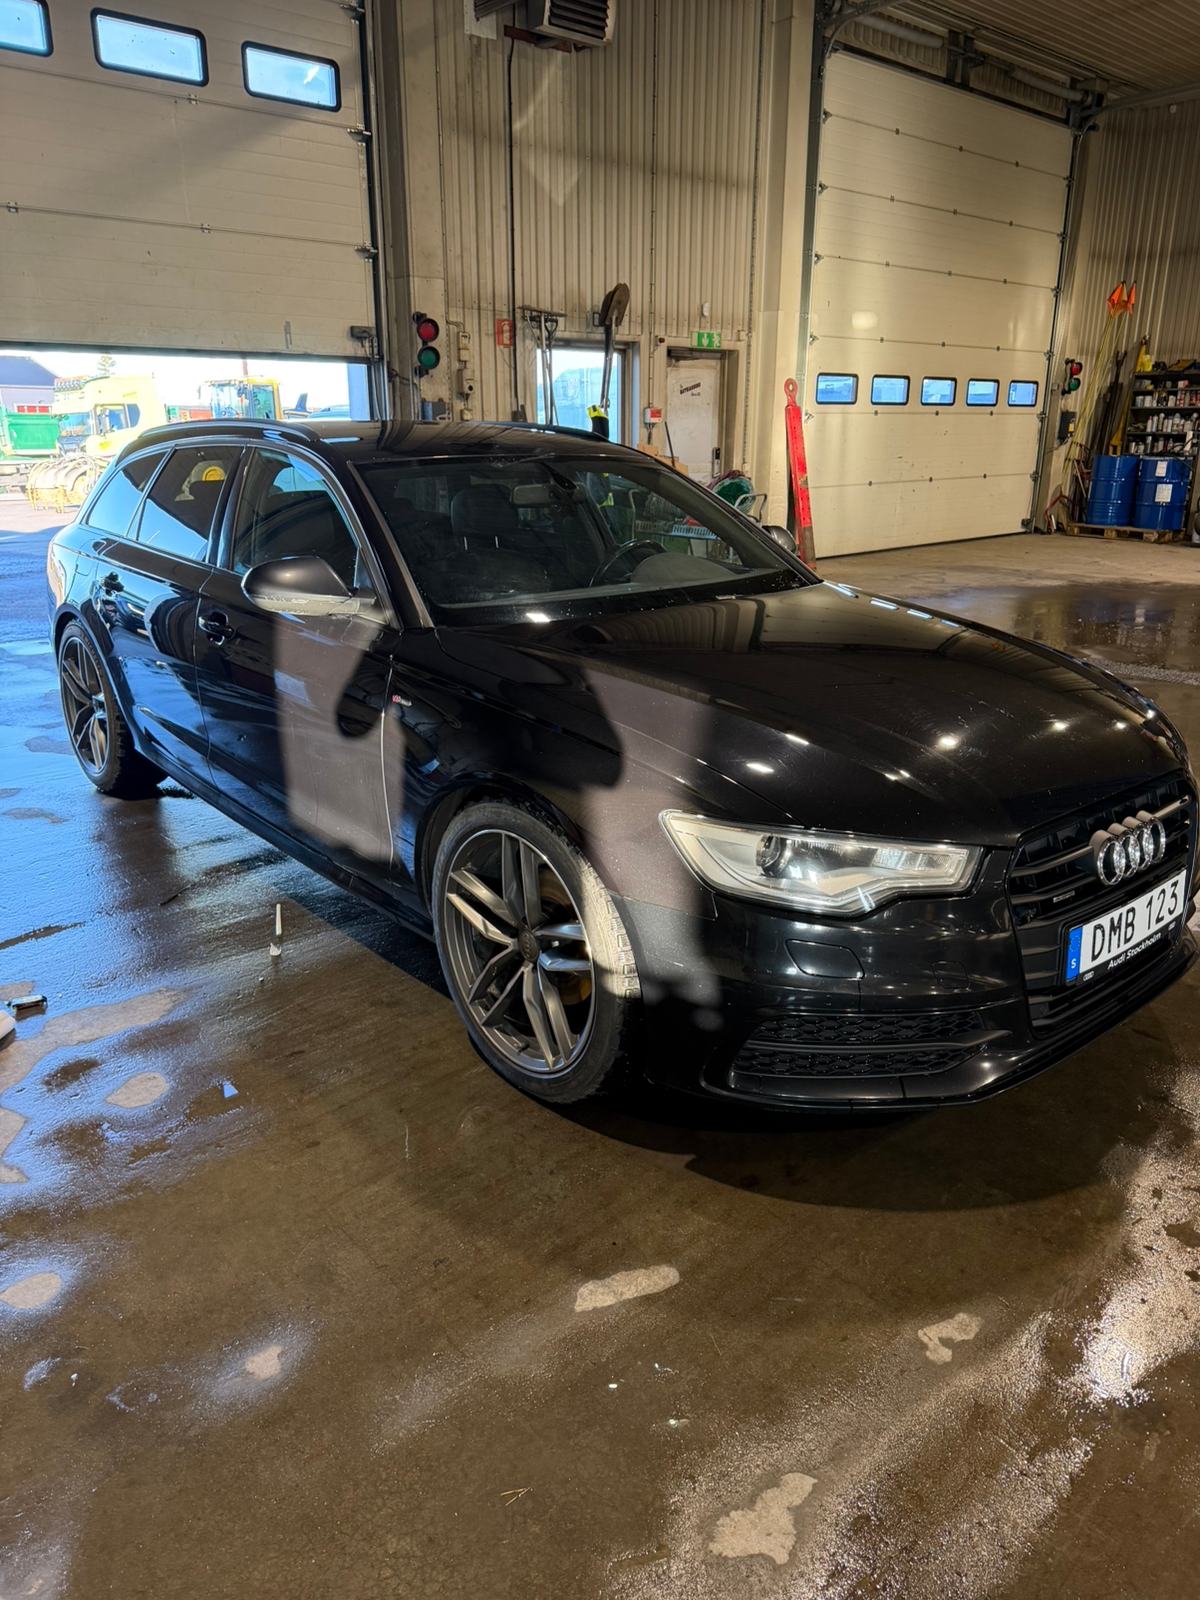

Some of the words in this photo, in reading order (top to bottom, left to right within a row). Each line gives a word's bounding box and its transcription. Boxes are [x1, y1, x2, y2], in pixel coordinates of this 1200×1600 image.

[1091, 906, 1136, 962] DMB
[1146, 879, 1179, 930] 123
[1070, 958, 1077, 969] S
[1107, 954, 1126, 970] Audi
[1126, 933, 1162, 959] Stockholm
